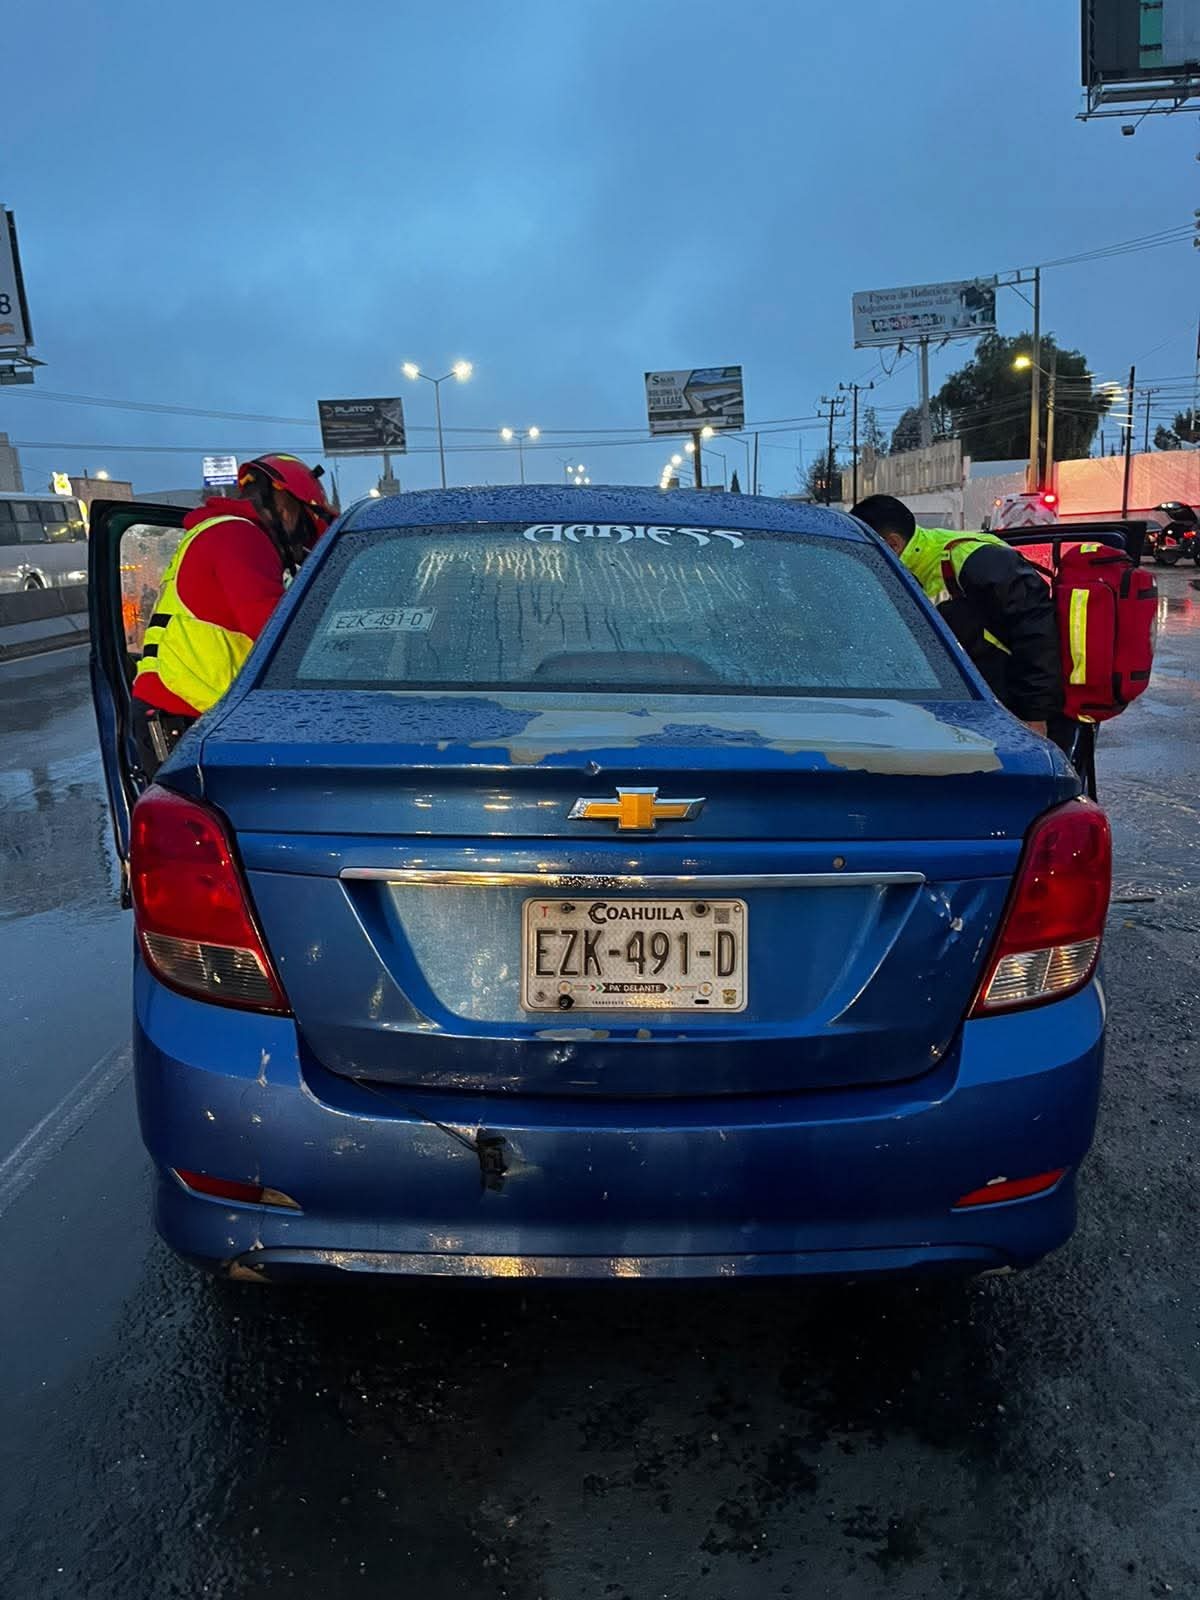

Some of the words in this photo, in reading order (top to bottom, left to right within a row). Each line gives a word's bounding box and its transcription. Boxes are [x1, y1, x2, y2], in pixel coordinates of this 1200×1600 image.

[335, 612, 424, 629] EZK-491-D
[541, 906, 549, 918] T
[588, 903, 684, 924] COAHUILA
[535, 930, 736, 977] EZK-491-D
[623, 984, 661, 992] DELANTE
